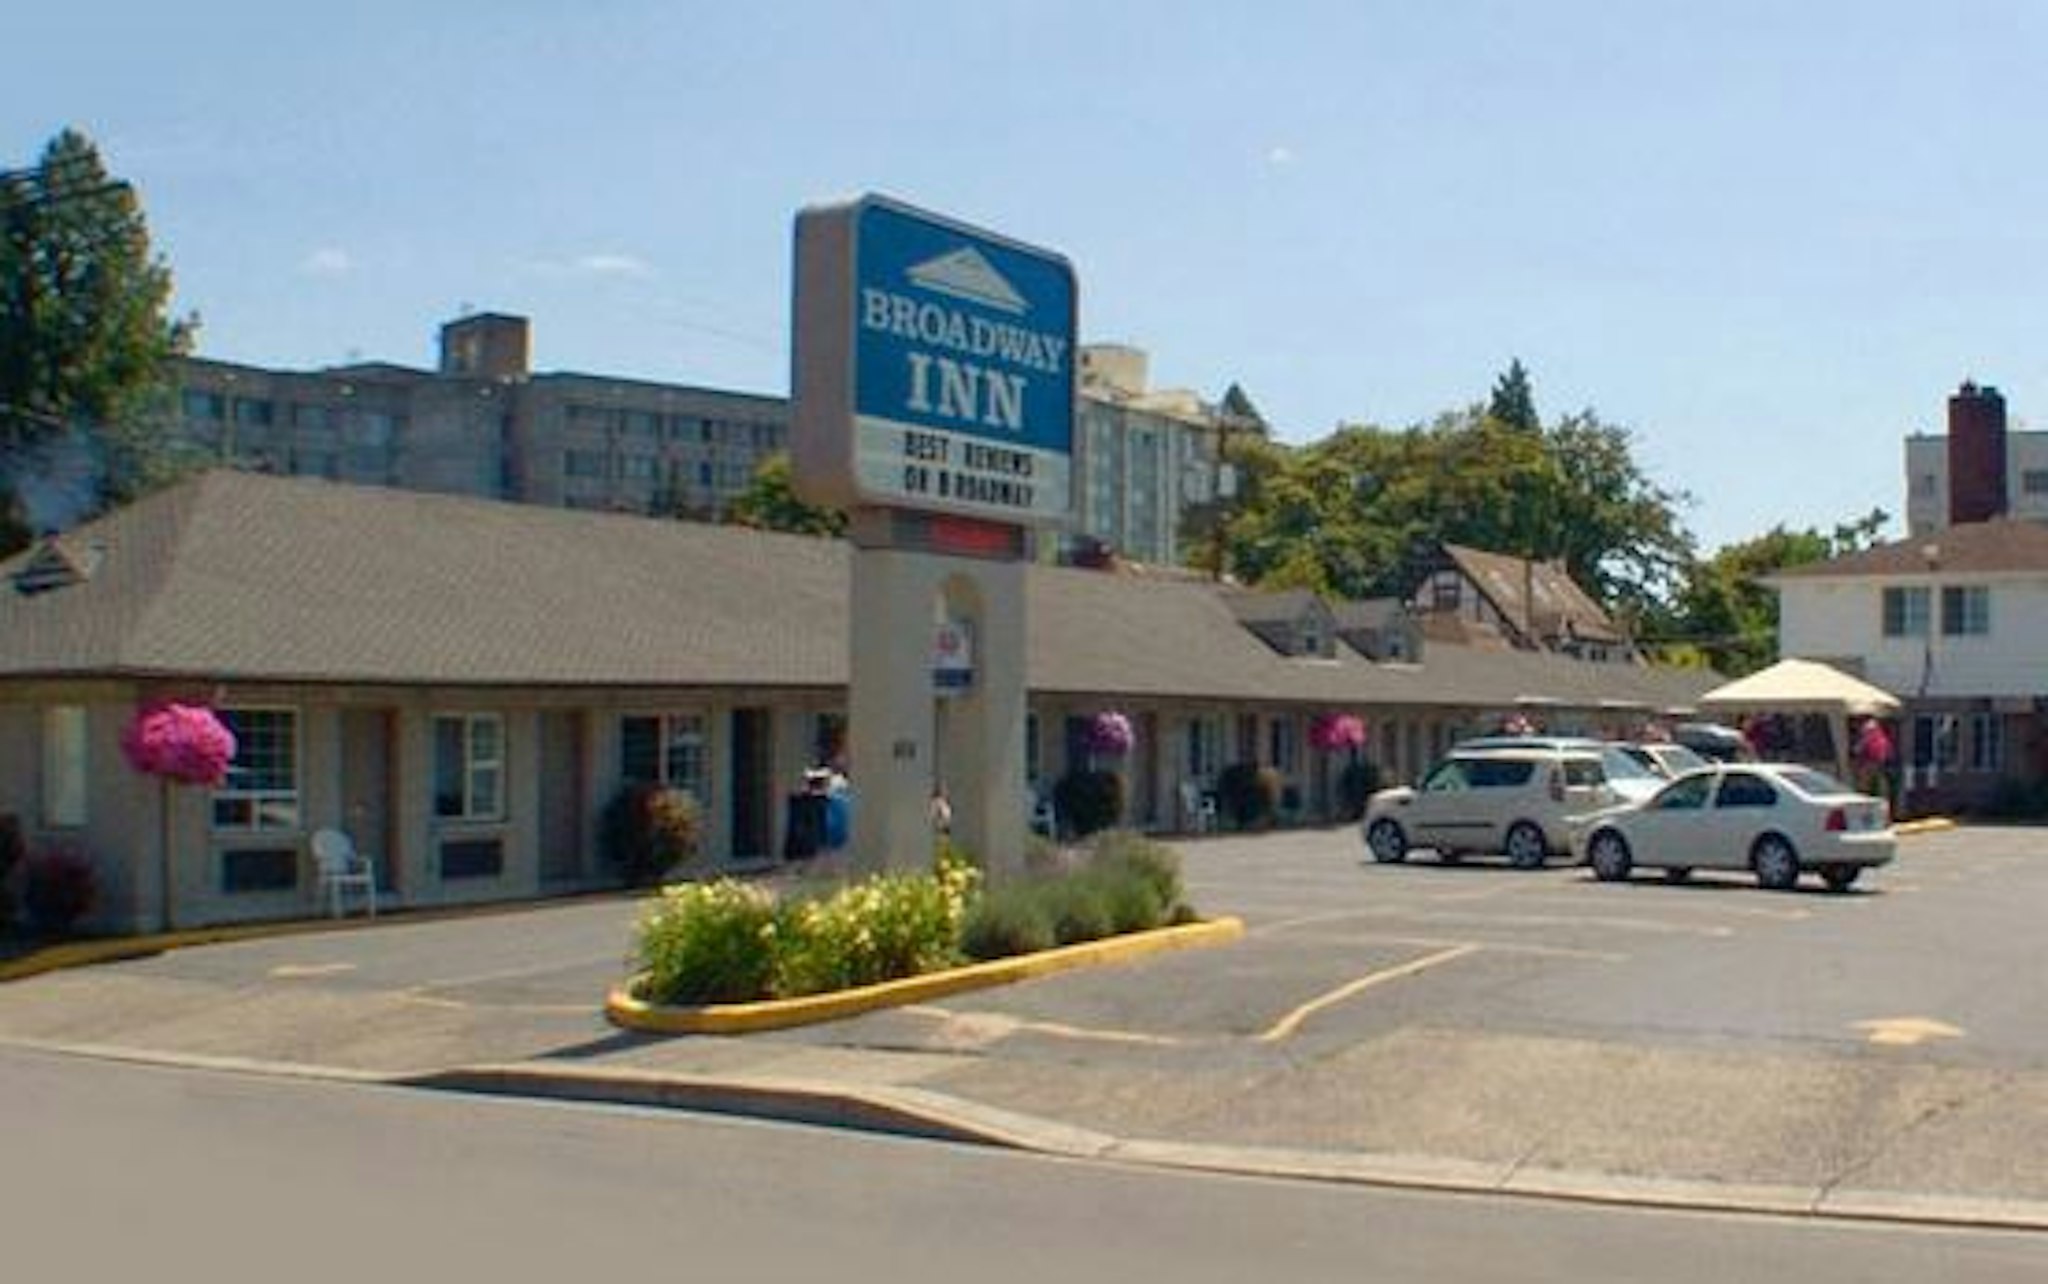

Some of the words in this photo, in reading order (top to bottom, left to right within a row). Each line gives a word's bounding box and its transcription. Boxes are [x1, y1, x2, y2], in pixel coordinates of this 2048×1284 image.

[863, 288, 1064, 371] BROADWAY
[906, 354, 1026, 430] INN
[904, 431, 949, 463] BEST
